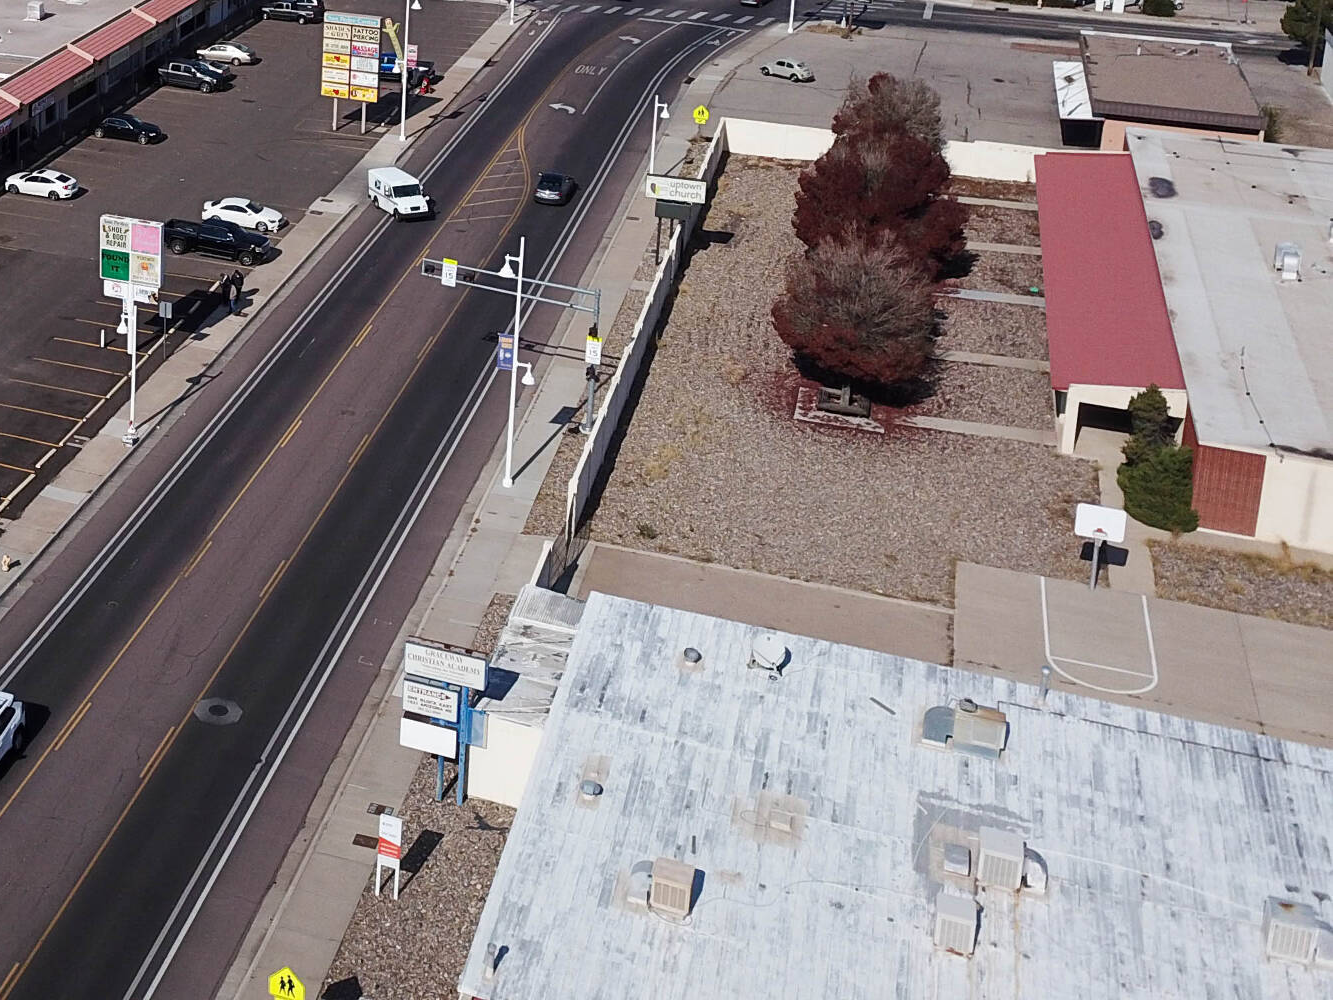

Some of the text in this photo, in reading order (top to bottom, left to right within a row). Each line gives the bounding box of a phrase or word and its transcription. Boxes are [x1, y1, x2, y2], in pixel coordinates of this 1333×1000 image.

[353, 28, 379, 36] TATTOO
[352, 33, 379, 42] PIERCING
[352, 44, 378, 54] MASSAGE
[574, 64, 608, 76] ONLY
[669, 181, 702, 191] uptown
[669, 190, 702, 200] church
[107, 225, 123, 234] SHOE
[112, 233, 127, 242] BOOT
[106, 240, 127, 249] REPAIR
[101, 252, 130, 264] FOUND
[445, 271, 454, 280] 15
[425, 649, 464, 664] GRACEWAY
[407, 652, 445, 667] CHRISTIAN
[447, 662, 481, 676] ACADEMY
